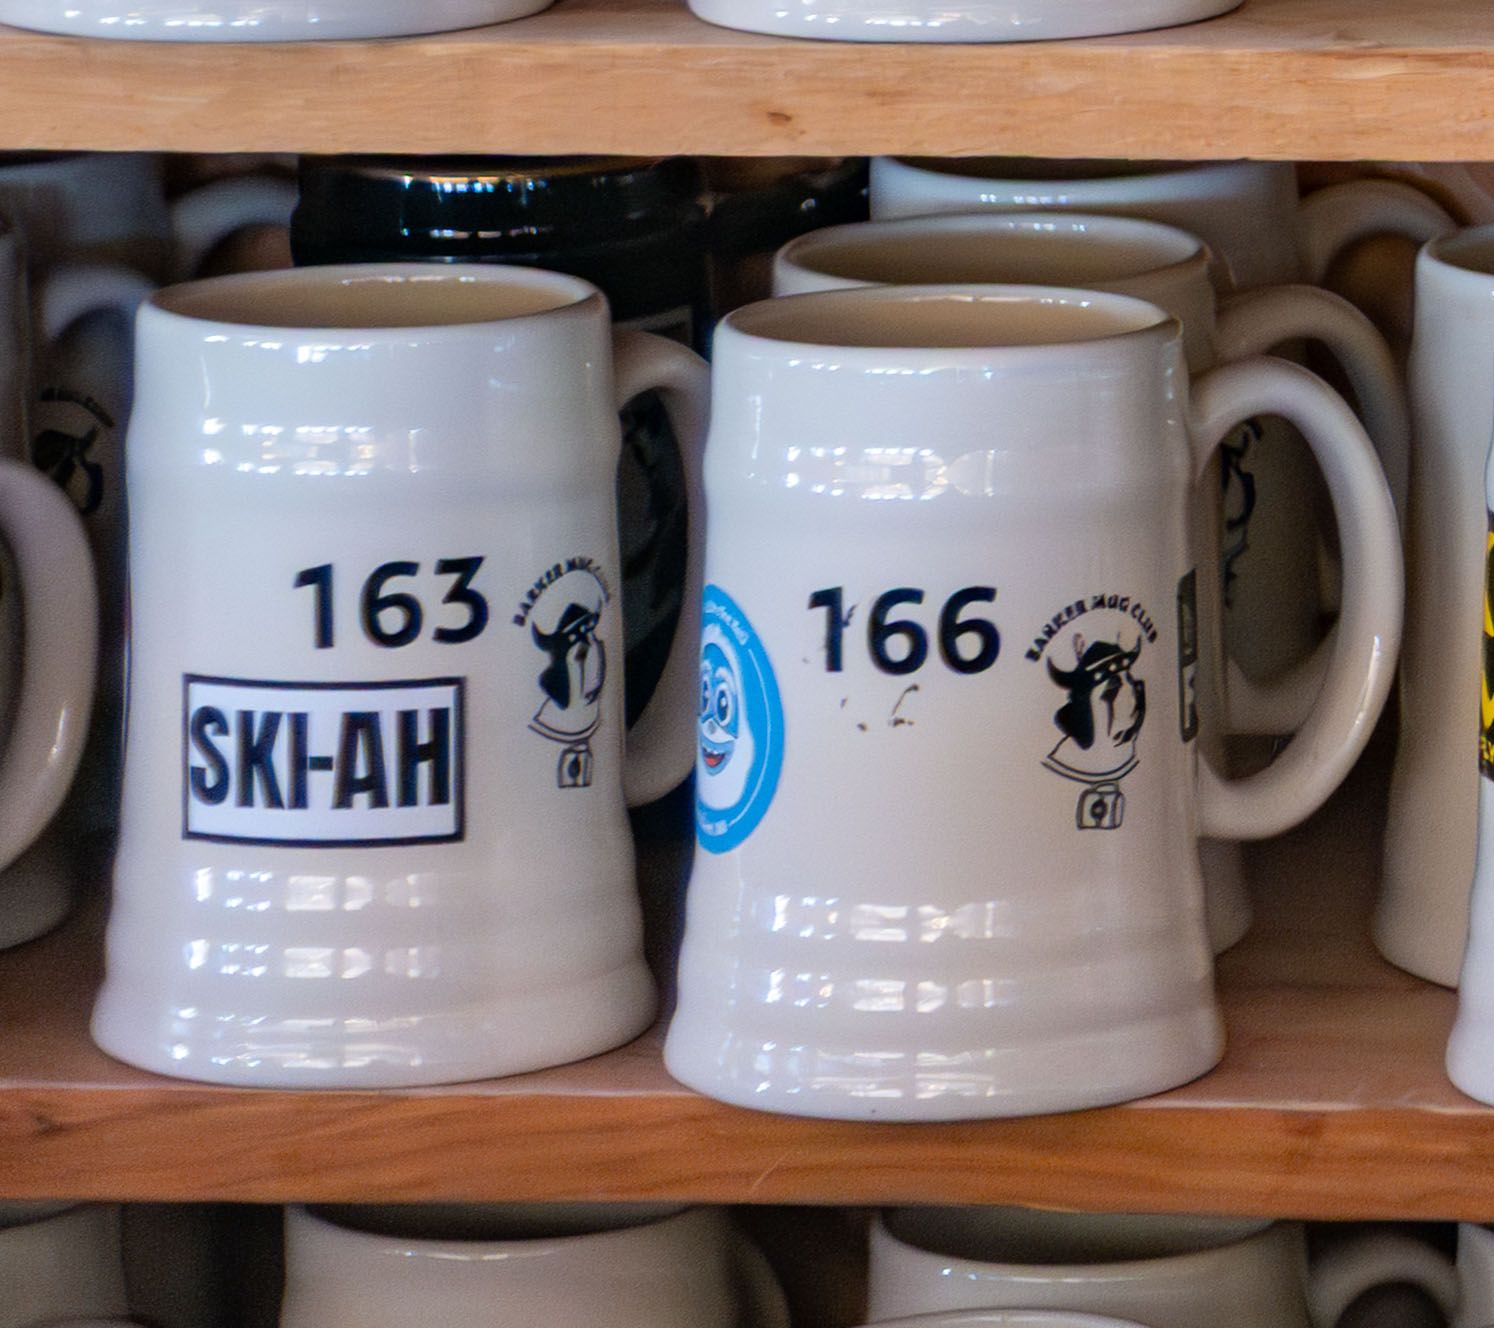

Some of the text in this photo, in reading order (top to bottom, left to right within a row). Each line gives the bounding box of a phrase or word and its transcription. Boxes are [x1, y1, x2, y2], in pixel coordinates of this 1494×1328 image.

[293, 556, 490, 651] 163
[805, 584, 1002, 676] 166
[188, 705, 452, 811] SKI-AH
